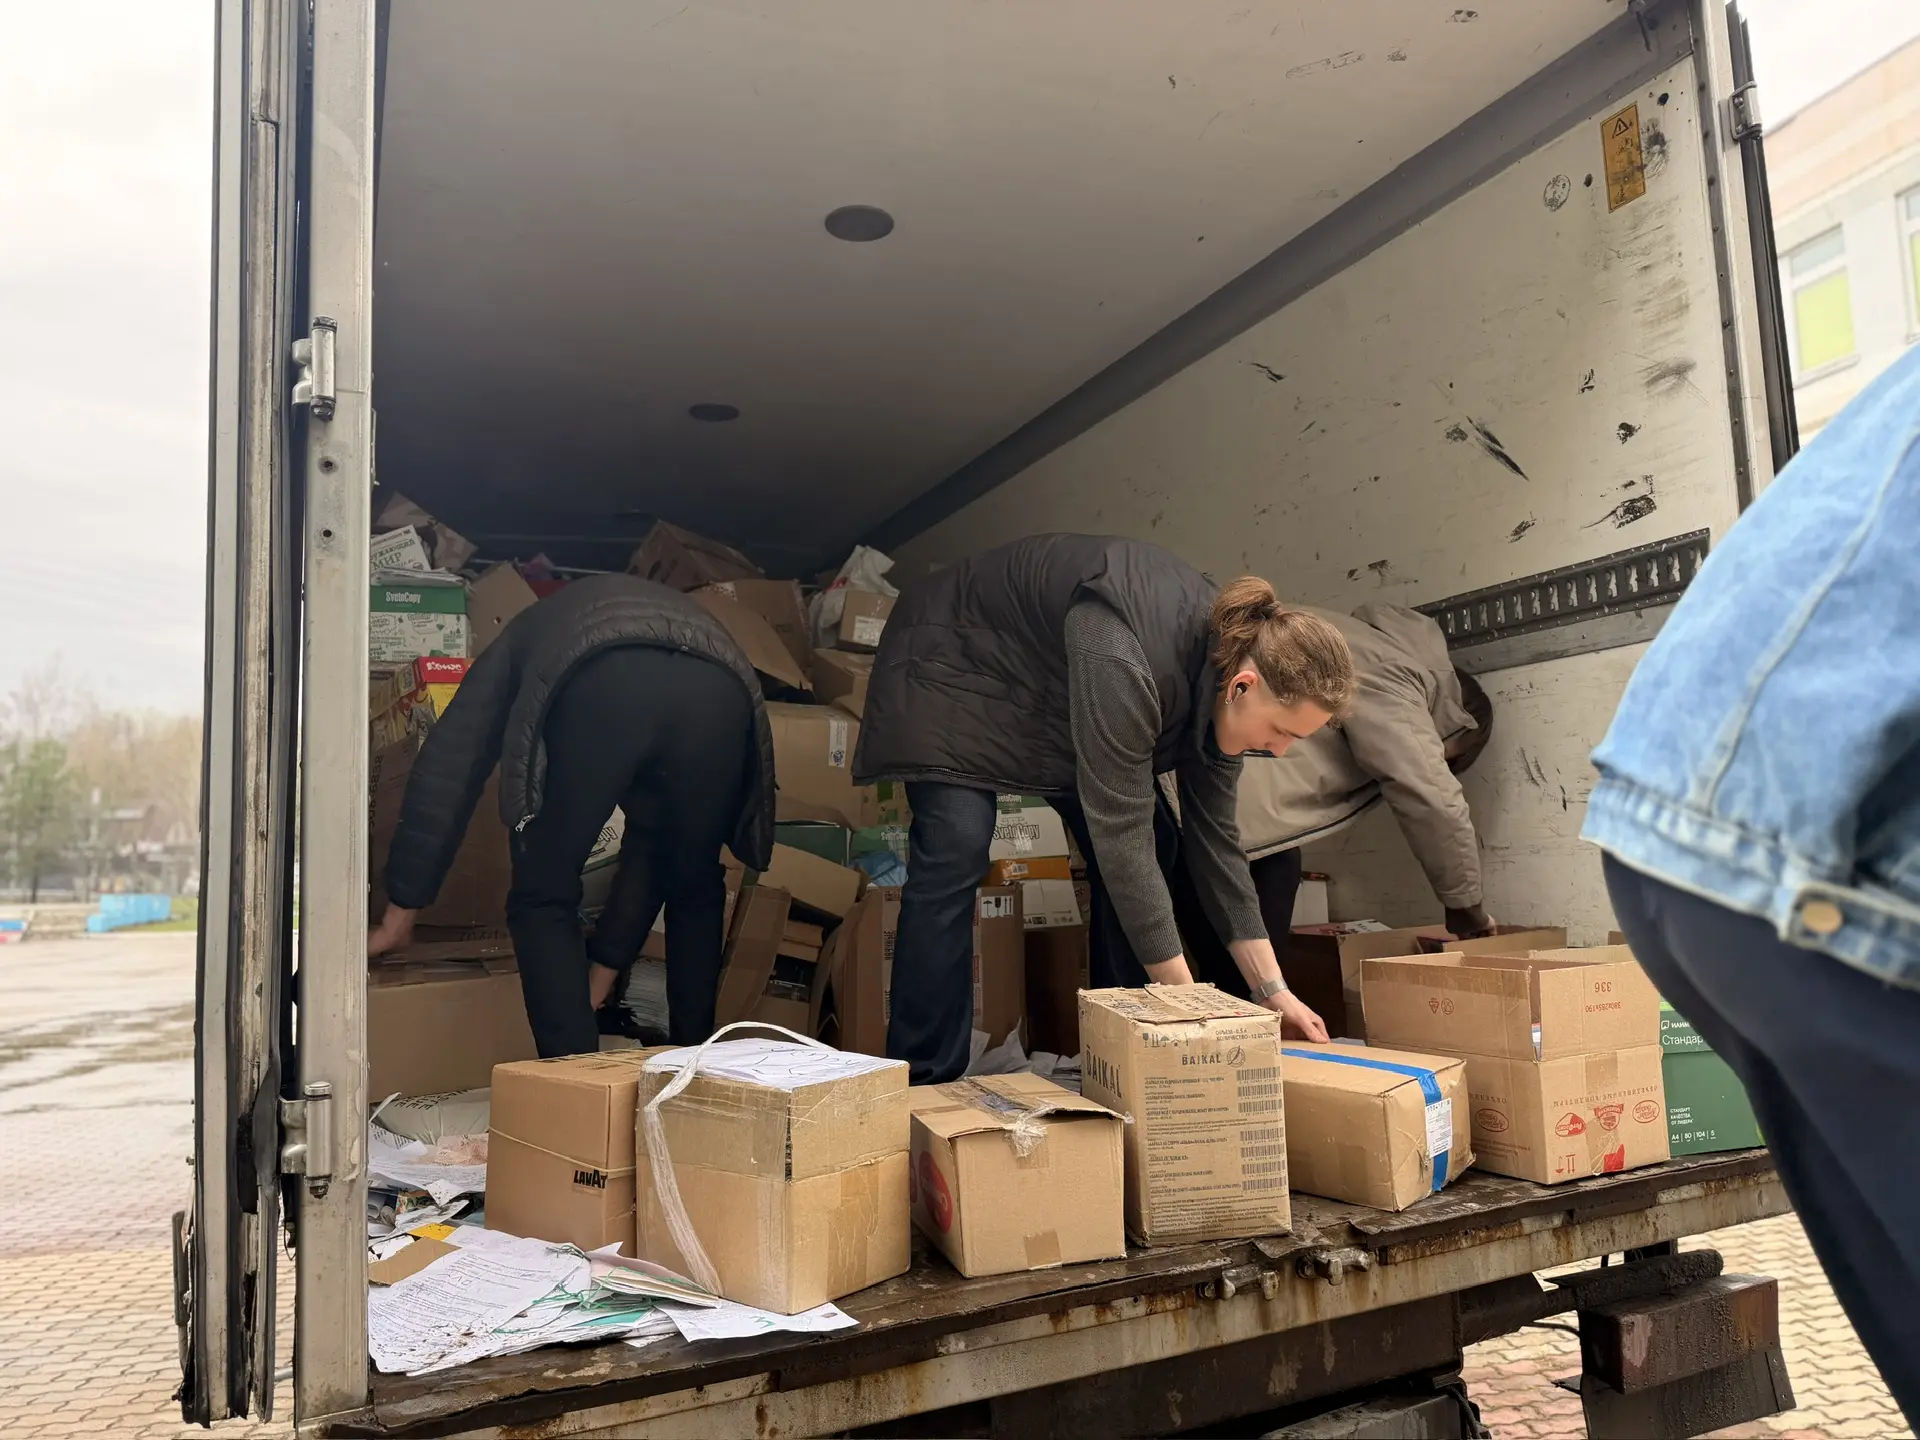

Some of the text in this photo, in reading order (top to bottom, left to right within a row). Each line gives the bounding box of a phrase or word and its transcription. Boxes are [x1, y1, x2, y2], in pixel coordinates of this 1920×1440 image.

[385, 591, 421, 604] SvetoCopy
[993, 823, 1040, 840] SvetoCopy
[1594, 981, 1612, 993] 336
[1662, 1034, 1704, 1045] Стандар
[1181, 1054, 1222, 1066] BAIKAL
[1085, 1045, 1123, 1098] BAIKAL
